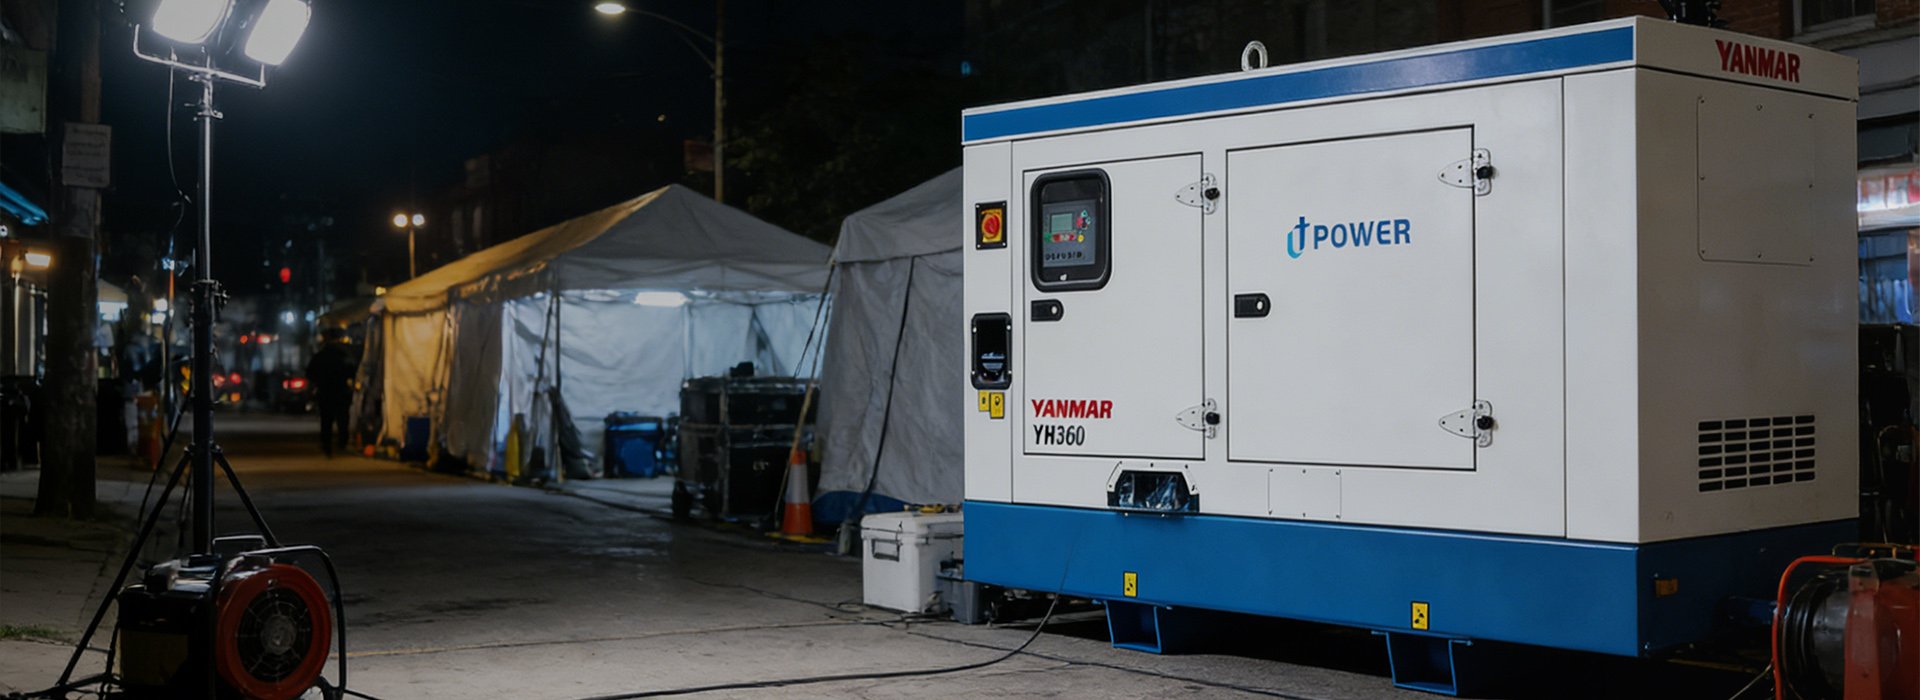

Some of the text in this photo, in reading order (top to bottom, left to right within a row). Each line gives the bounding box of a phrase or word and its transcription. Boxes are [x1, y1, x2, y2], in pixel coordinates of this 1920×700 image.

[1715, 38, 1801, 84] YANMAR
[1031, 399, 1113, 419] YANMAR
[1033, 424, 1086, 446] YH360
